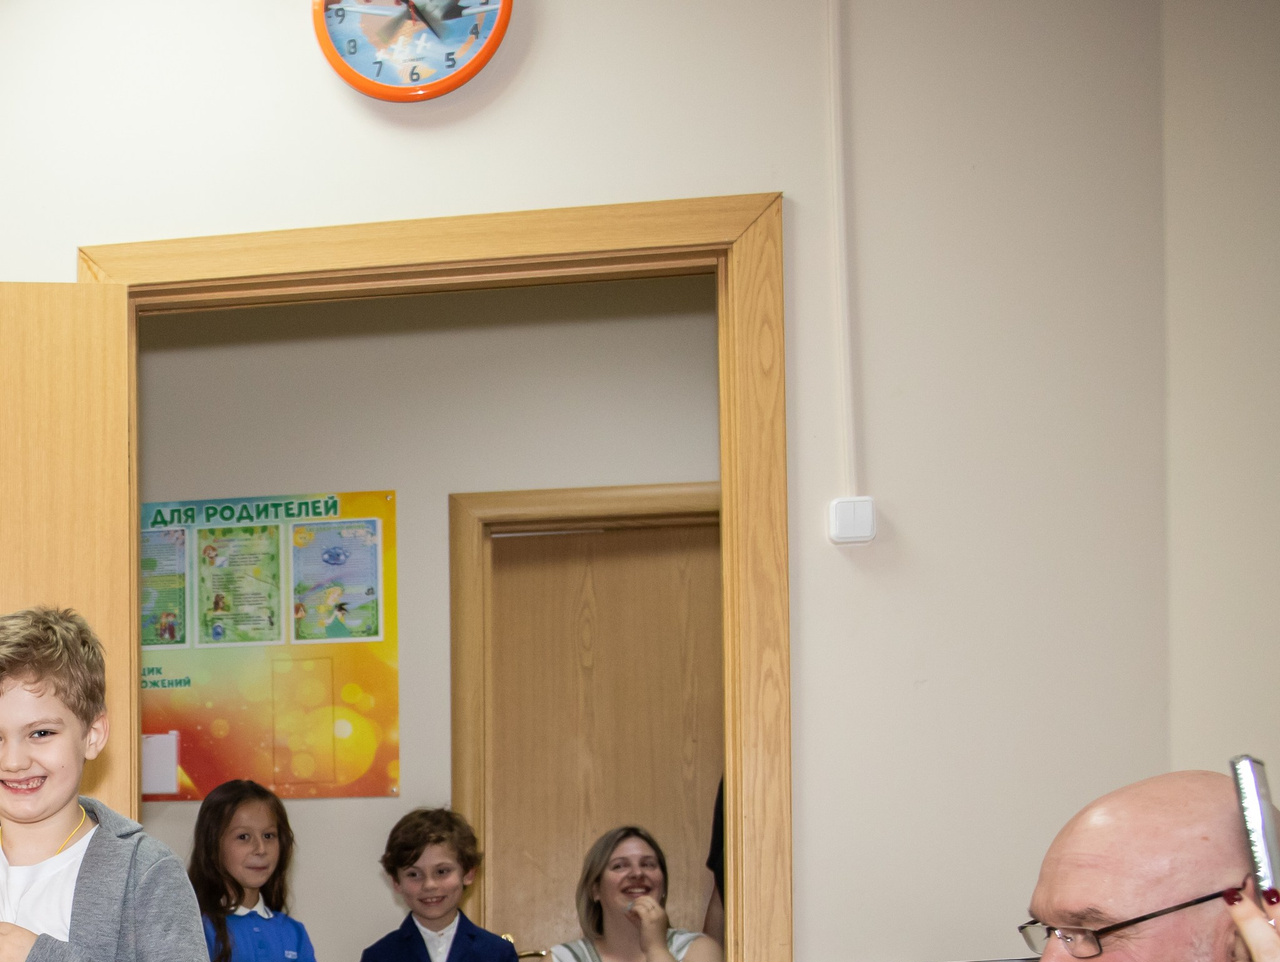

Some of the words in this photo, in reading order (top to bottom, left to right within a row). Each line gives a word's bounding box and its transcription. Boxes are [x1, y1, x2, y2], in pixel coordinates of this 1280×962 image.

[335, 8, 345, 24] 9
[470, 23, 480, 39] 4
[347, 39, 358, 55] 8
[445, 52, 456, 69] 5
[372, 61, 383, 77] 7
[409, 66, 420, 82] 6
[150, 507, 196, 528] ДЛЯ
[205, 496, 339, 523] РОДИТЕЛЕЙ
